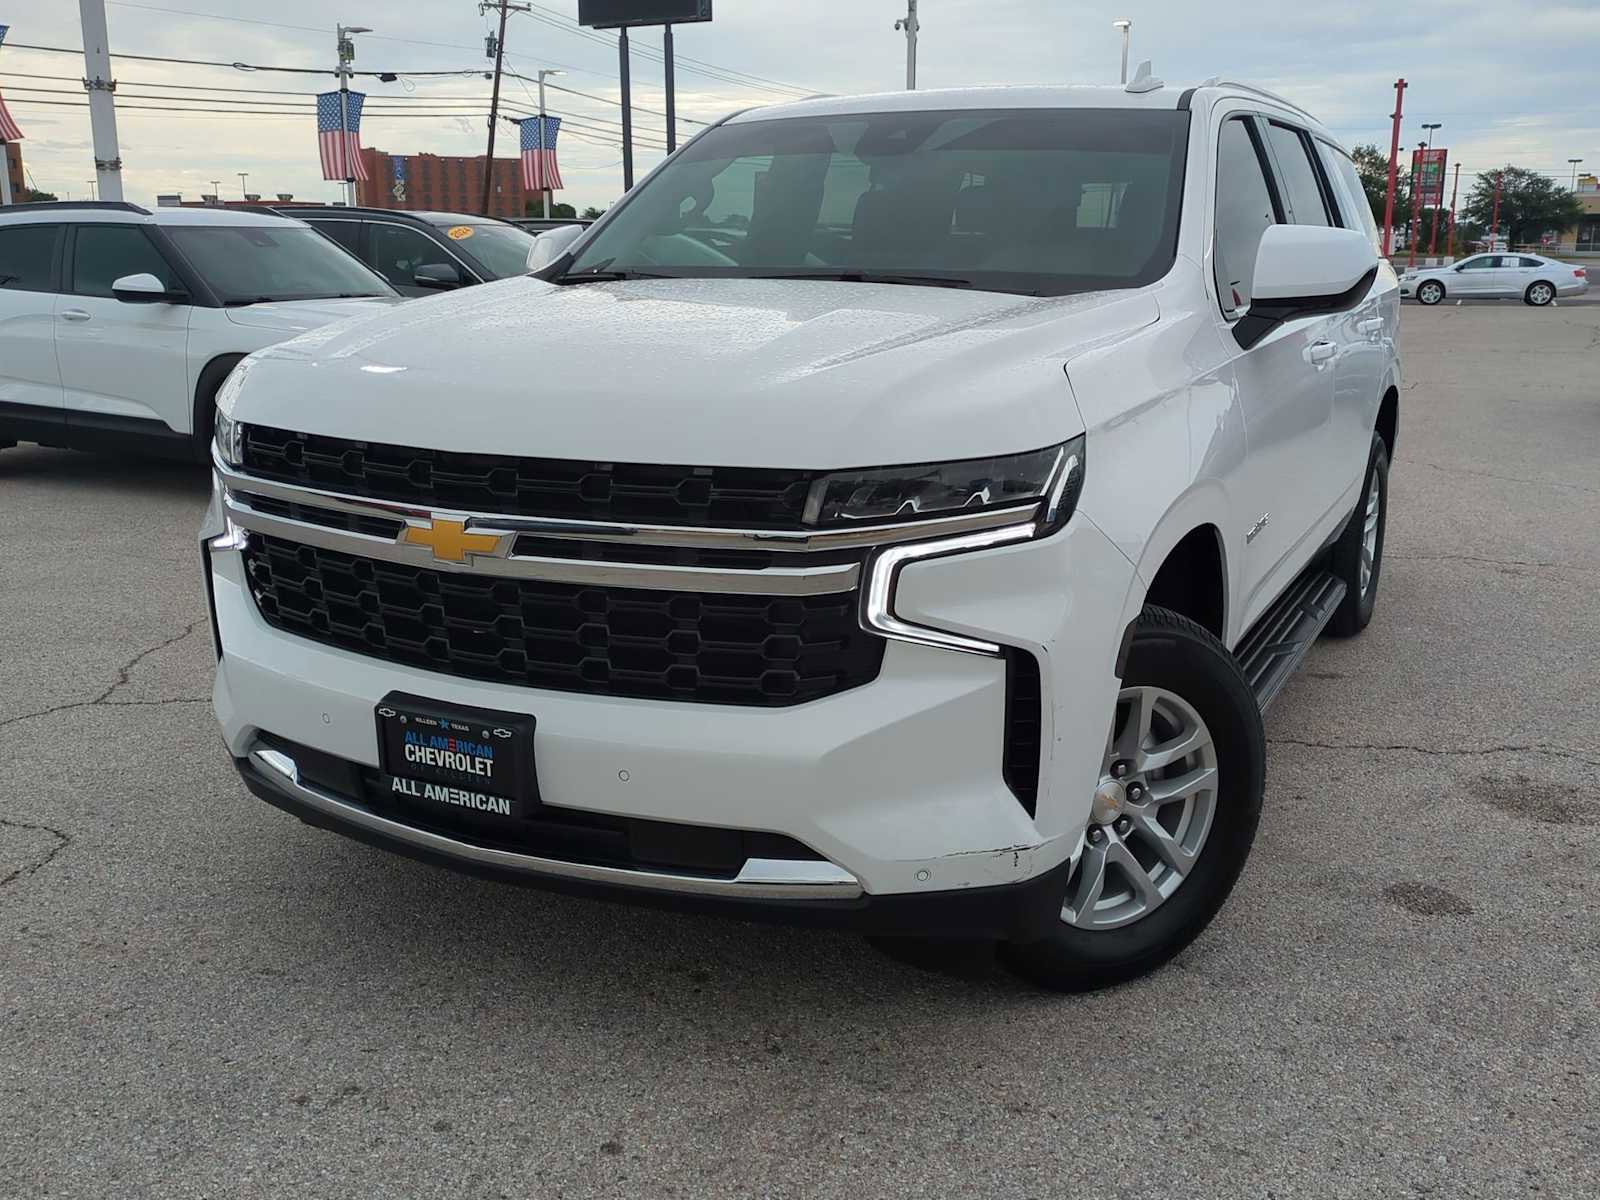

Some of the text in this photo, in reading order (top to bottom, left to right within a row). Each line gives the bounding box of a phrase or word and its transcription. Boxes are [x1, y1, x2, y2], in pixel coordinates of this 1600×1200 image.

[415, 717, 470, 732] KILLEEN TEXAS
[405, 731, 494, 759] ALL AMERICAN
[405, 743, 494, 777] CHEVROLET
[392, 776, 512, 816] ALL AMERICAN
